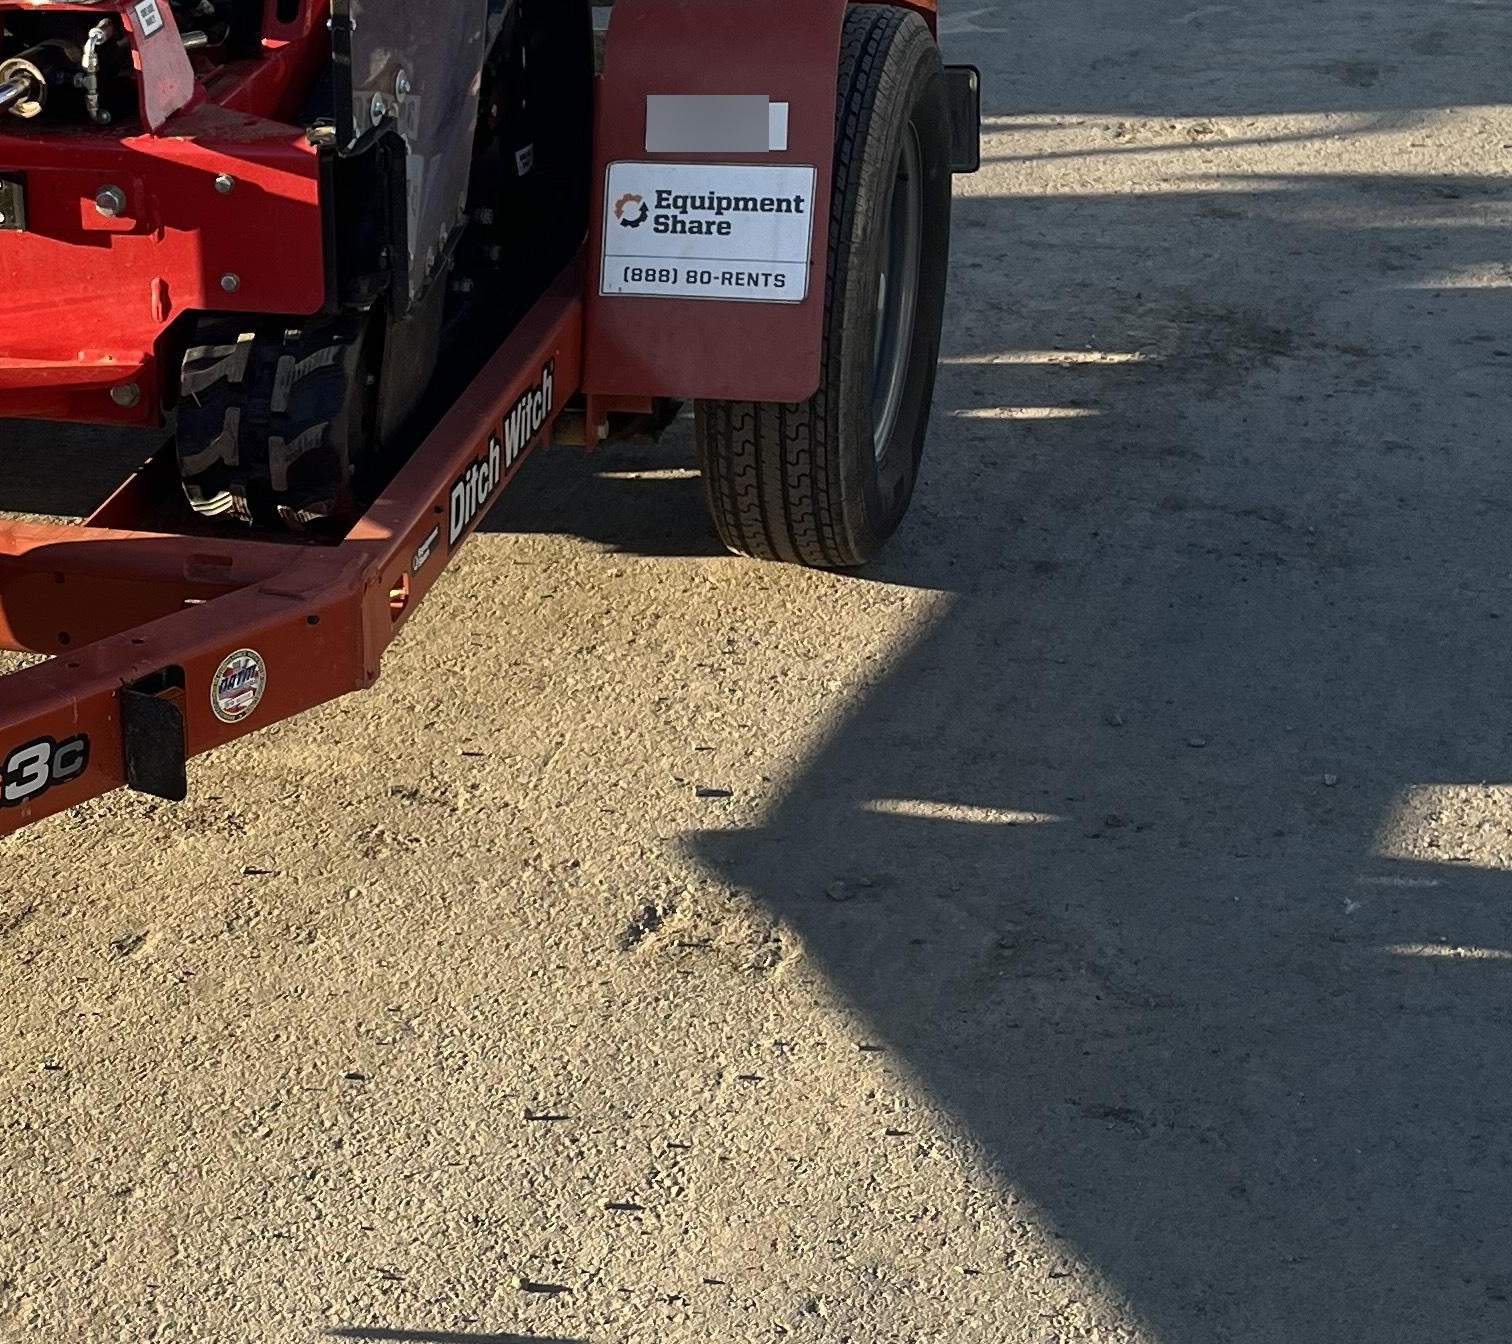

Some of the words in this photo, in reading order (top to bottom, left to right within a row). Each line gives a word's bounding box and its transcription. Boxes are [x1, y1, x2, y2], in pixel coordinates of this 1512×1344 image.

[654, 189, 805, 216] Equipment
[653, 214, 732, 236] Share
[623, 266, 679, 285] (888)
[685, 269, 787, 289] 80-RENTS
[449, 436, 501, 546] Ditch
[504, 367, 554, 469] Witch
